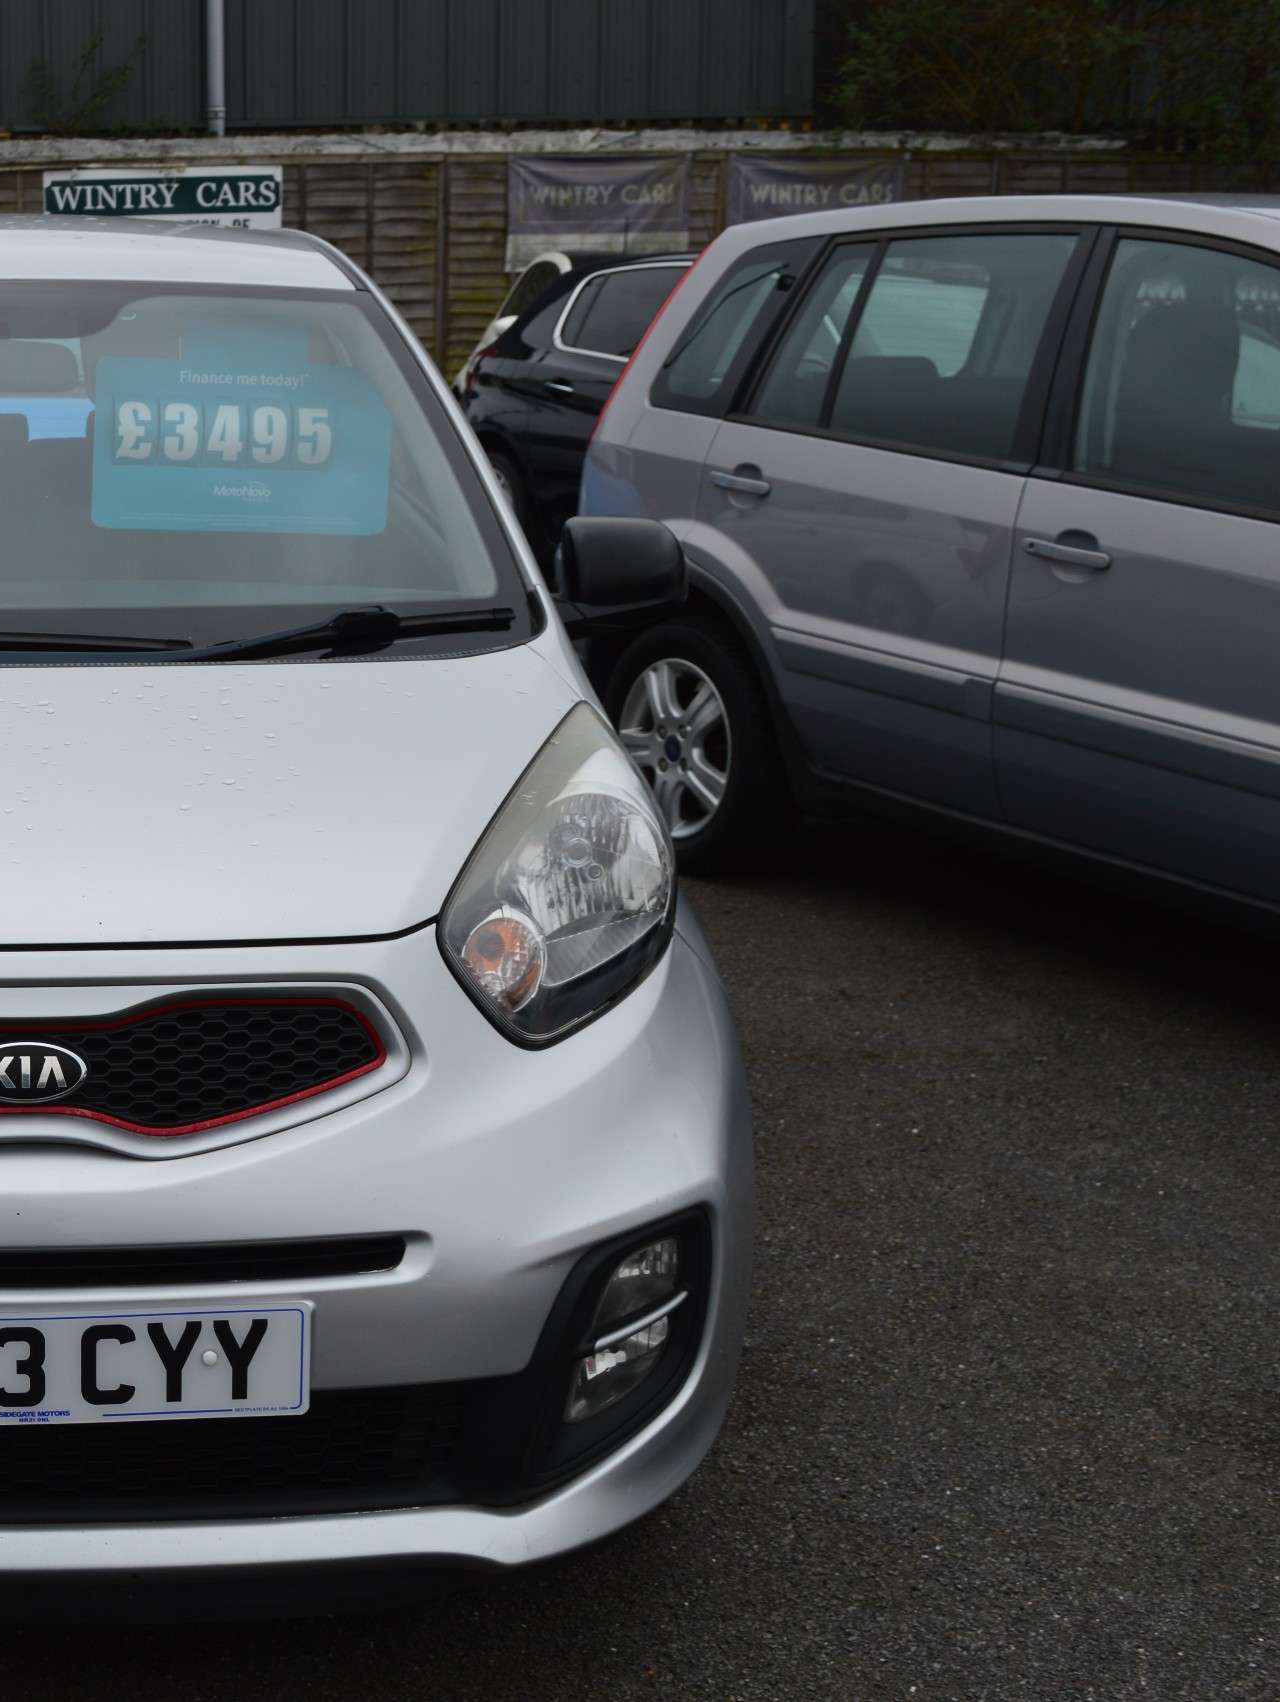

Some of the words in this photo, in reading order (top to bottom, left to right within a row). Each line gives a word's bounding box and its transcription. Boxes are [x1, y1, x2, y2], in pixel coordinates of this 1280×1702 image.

[51, 182, 180, 211] WINTRY
[196, 180, 277, 208] CARS
[530, 184, 615, 207] WINTRY
[750, 183, 834, 206] WINTRY
[839, 182, 894, 204] CARS
[179, 369, 234, 385] Finance
[236, 373, 258, 386] me
[115, 400, 332, 465] £3495
[80, 1318, 269, 1406] CYY
